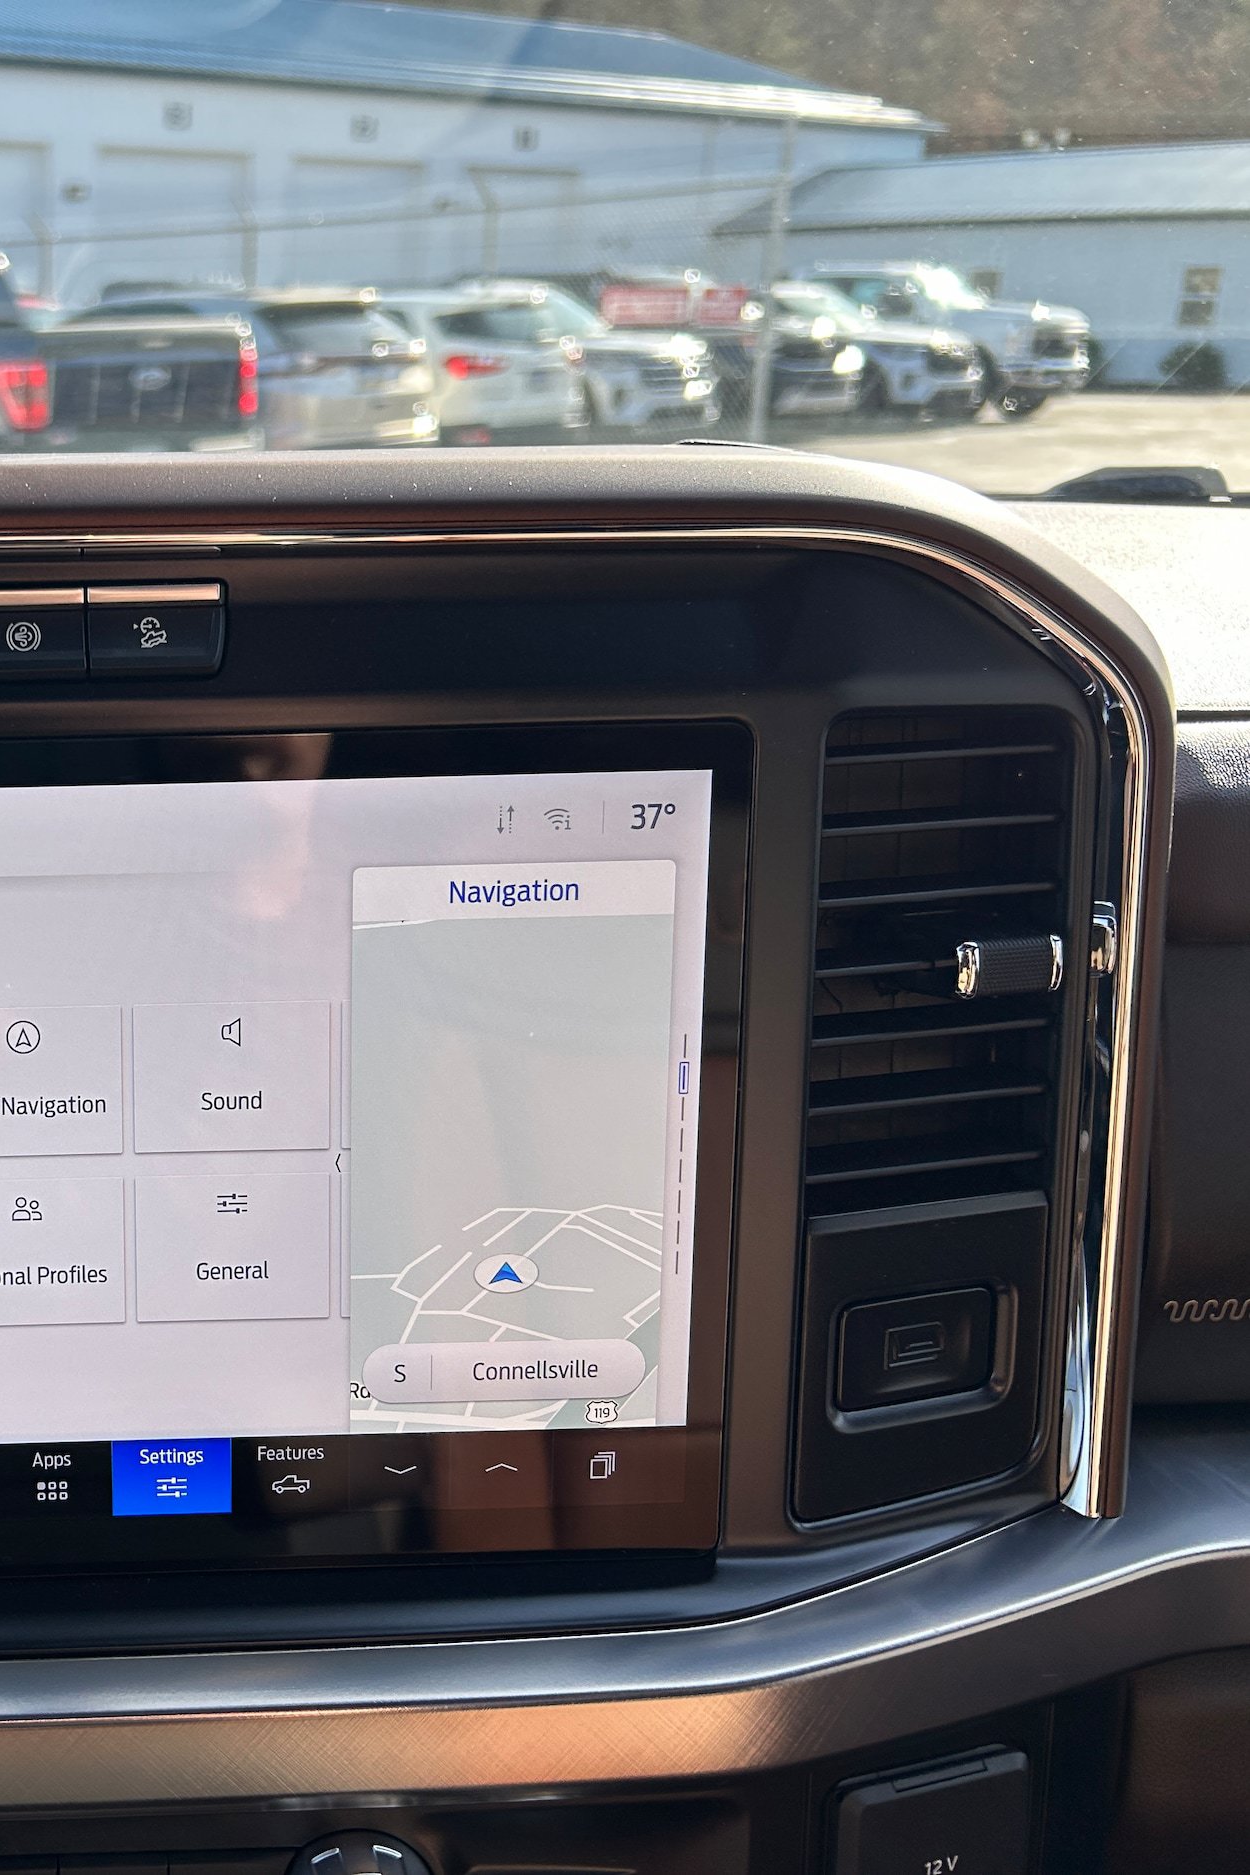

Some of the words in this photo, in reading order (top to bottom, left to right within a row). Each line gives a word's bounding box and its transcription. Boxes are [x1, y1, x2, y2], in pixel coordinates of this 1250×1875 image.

[630, 803, 676, 830] 37°
[449, 878, 579, 907] Navigation
[1, 1096, 106, 1118] Navigation
[201, 1090, 262, 1111] Sound
[37, 1264, 108, 1285] Profiles
[196, 1260, 269, 1281] General
[393, 1364, 406, 1383] S
[473, 1359, 598, 1381] Connellsville
[592, 1404, 612, 1421] 119
[32, 1451, 72, 1470] Apps
[139, 1448, 204, 1469] Settings
[257, 1445, 325, 1462] Features
[925, 1859, 943, 1875] 12
[946, 1855, 959, 1871] V
